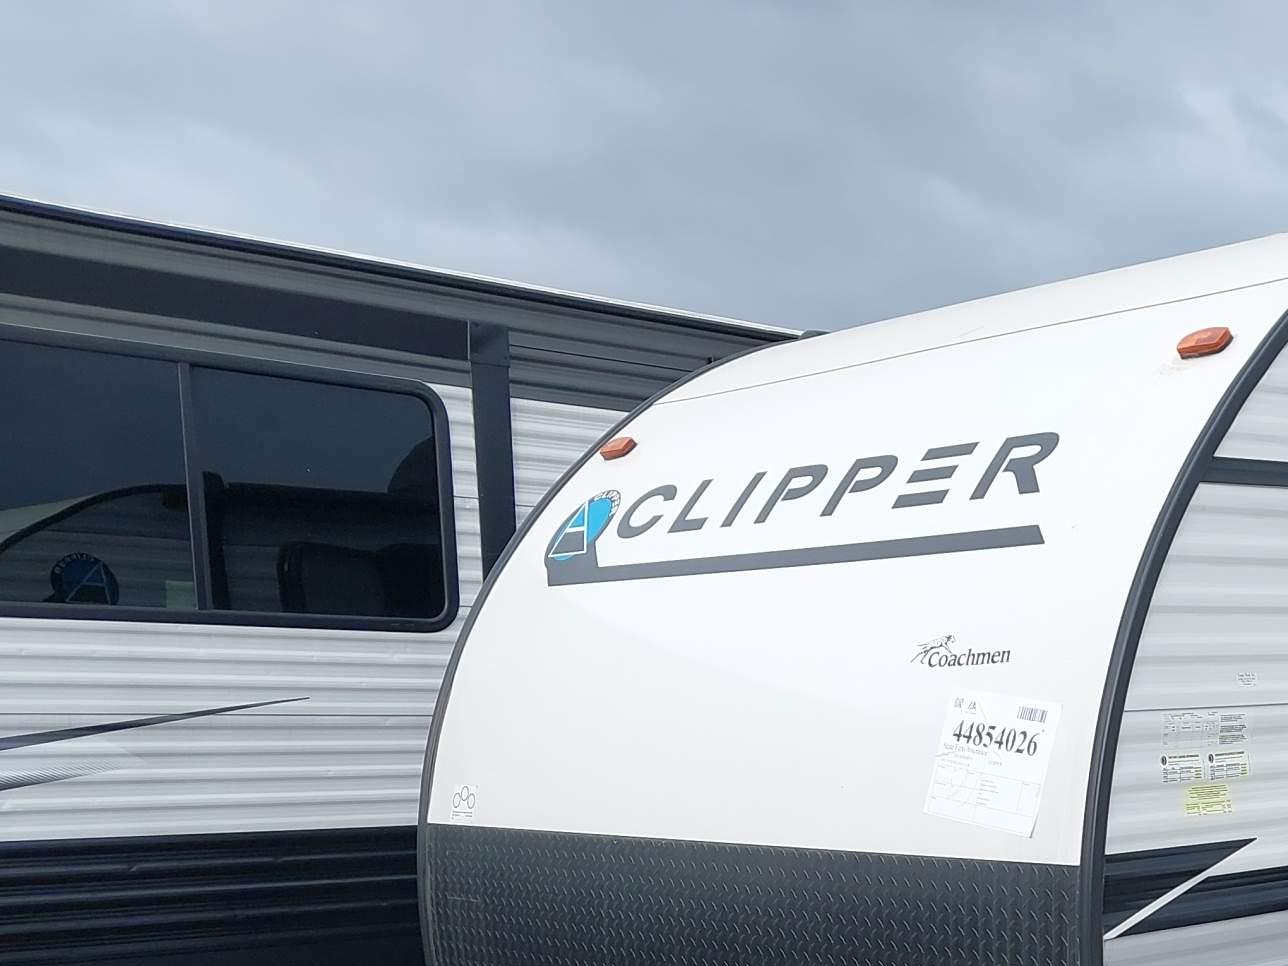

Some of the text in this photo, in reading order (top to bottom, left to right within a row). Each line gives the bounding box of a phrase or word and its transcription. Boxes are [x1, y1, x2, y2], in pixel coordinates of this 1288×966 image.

[617, 432, 1060, 540] CLIPPER
[927, 648, 1011, 668] Coachmen
[952, 720, 1041, 757] 44854026
